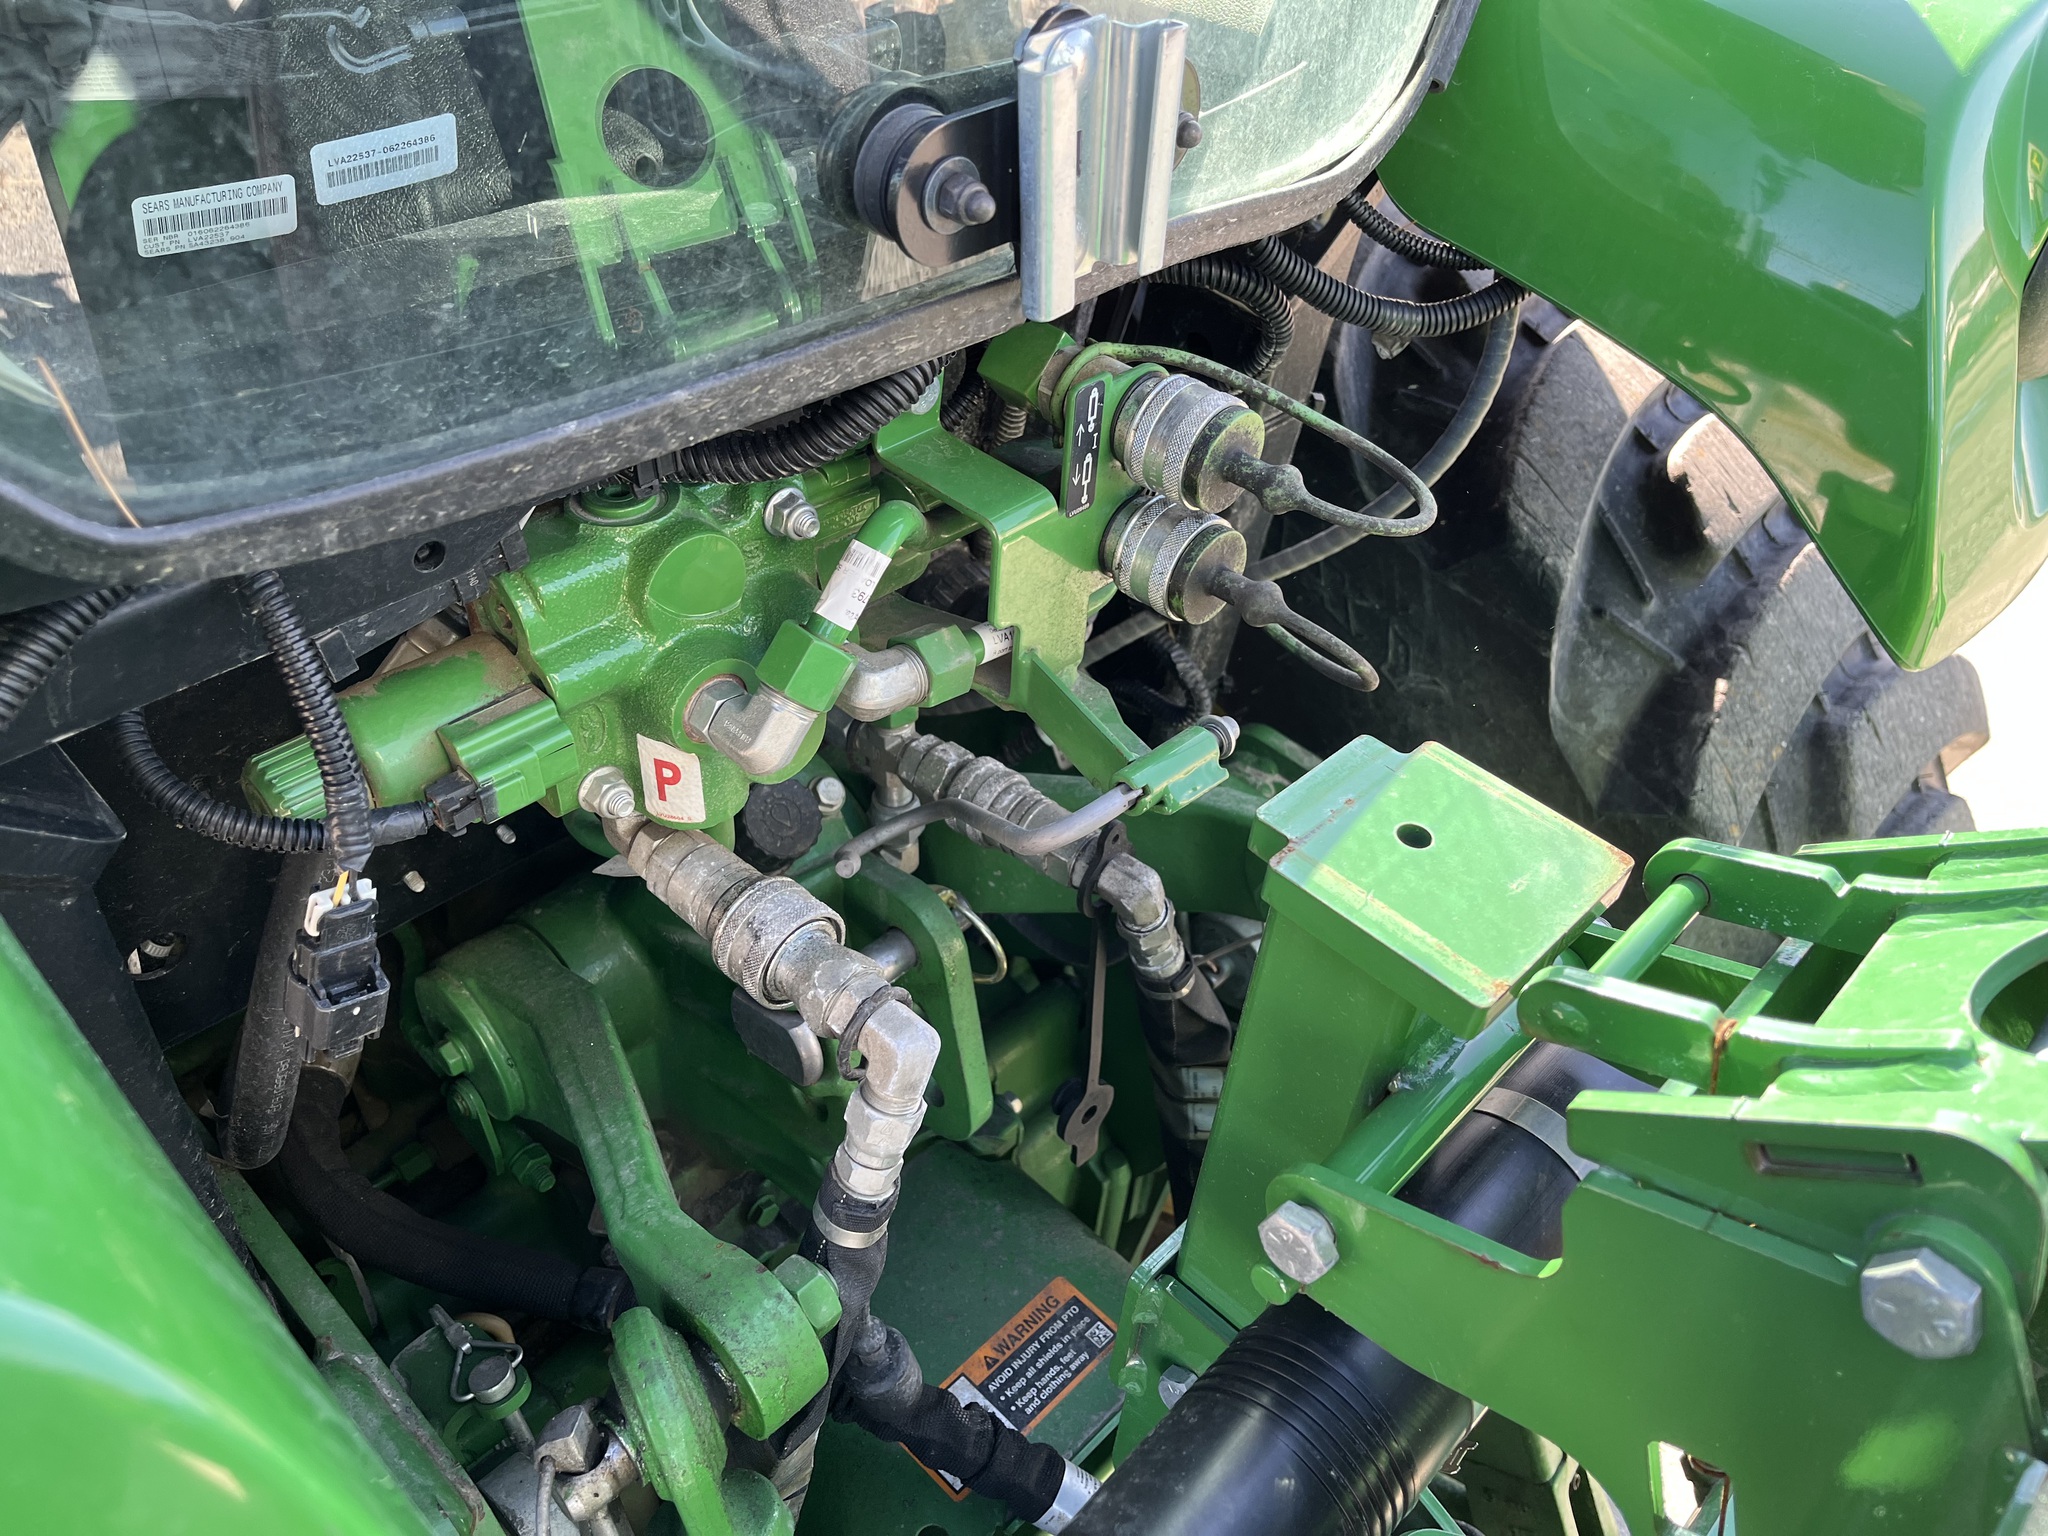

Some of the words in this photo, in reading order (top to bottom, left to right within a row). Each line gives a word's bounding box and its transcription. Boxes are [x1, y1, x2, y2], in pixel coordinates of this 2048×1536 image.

[328, 134, 436, 167] LVA22537-062264386
[142, 199, 170, 214] SEARS
[173, 188, 243, 209] MANUFACTURING
[246, 181, 283, 197] COMPANY
[143, 241, 165, 250] CUST
[188, 231, 230, 243] LVA22537
[144, 246, 171, 255] SEARS
[653, 757, 682, 802] P
[987, 1367, 1014, 1393] AVOID
[1011, 1340, 1041, 1370] INJURY
[1039, 1319, 1065, 1344] FROM
[1061, 1305, 1080, 1323] PTO
[993, 1295, 1061, 1356] WARNING
[1004, 1377, 1027, 1398] Keep
[1025, 1365, 1037, 1379] all
[1036, 1343, 1064, 1369] shields
[1061, 1334, 1072, 1344] in
[1070, 1316, 1091, 1337] place
[1015, 1387, 1038, 1409] Keep
[1035, 1363, 1064, 1389] hands,
[1059, 1349, 1077, 1365] feet
[1024, 1400, 1041, 1415] and
[1039, 1369, 1073, 1400] clothing
[1069, 1351, 1090, 1371] away
